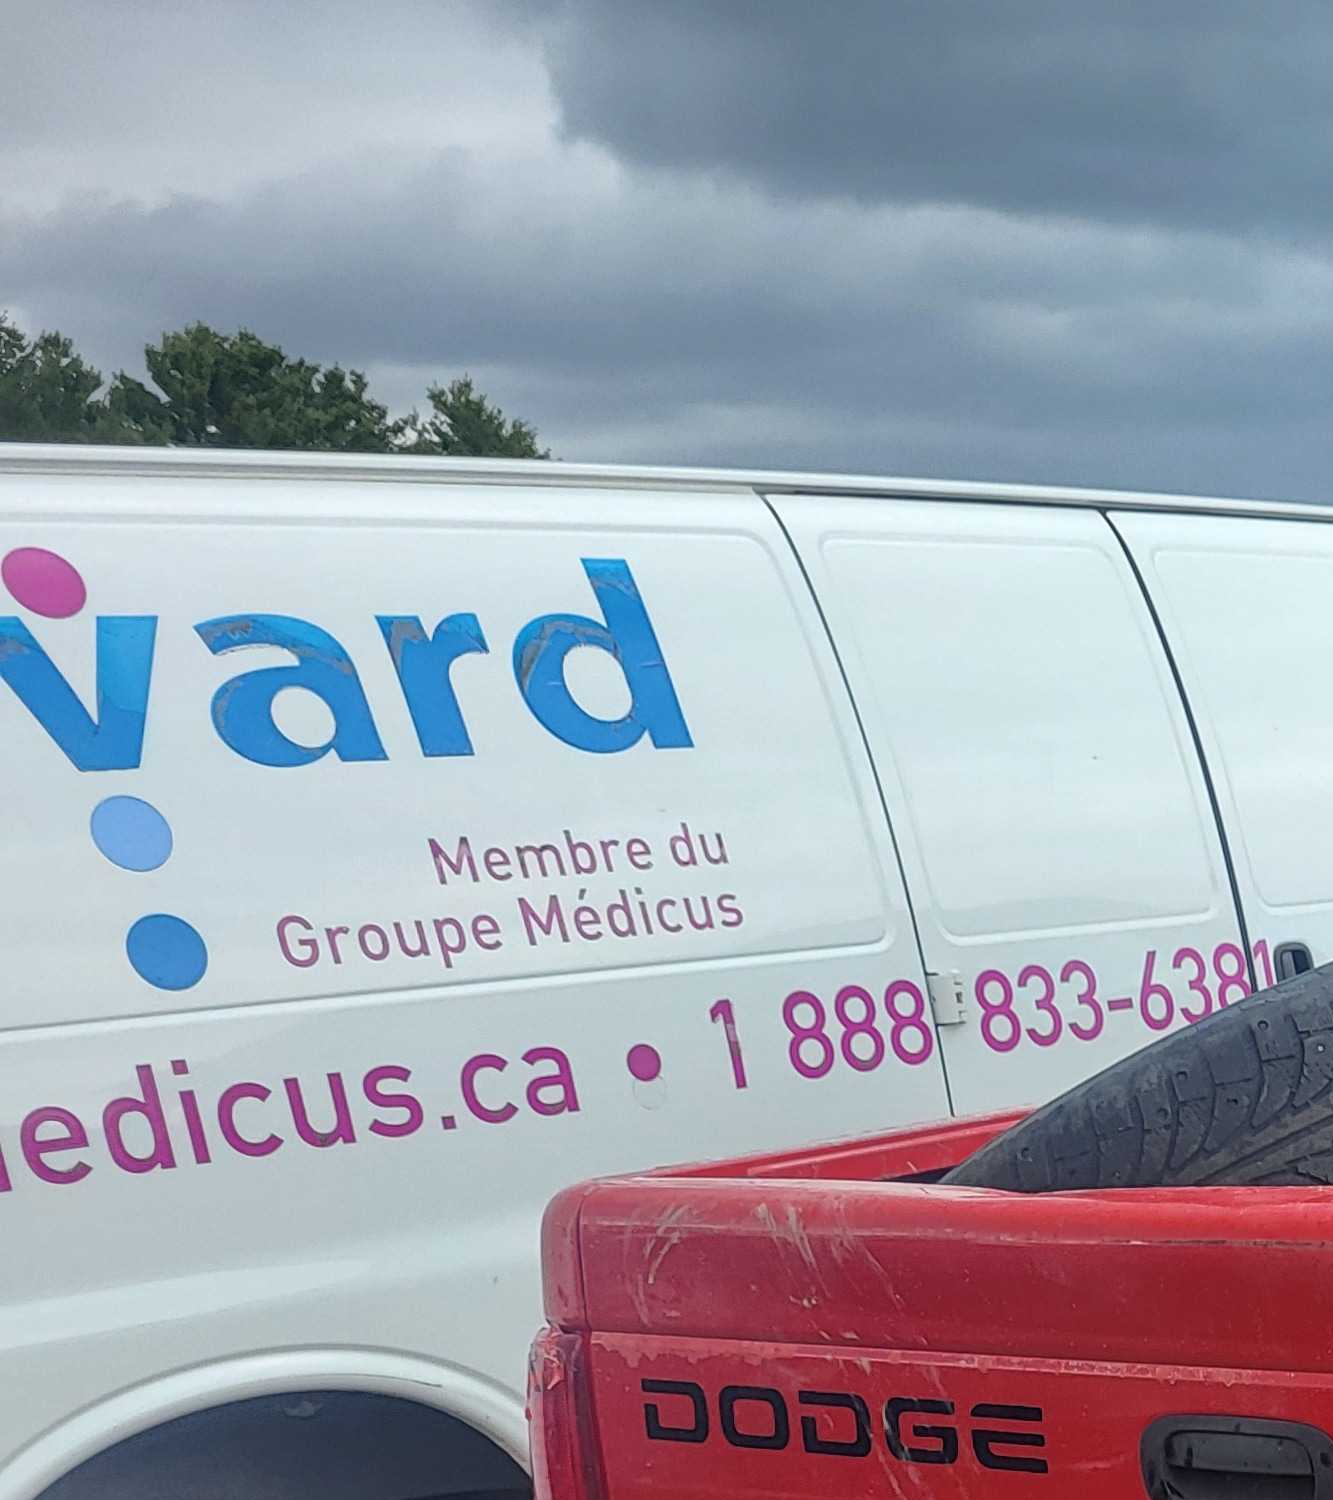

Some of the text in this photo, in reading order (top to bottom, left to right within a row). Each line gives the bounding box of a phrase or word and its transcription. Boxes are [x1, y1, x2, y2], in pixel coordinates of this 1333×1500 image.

[0, 557, 694, 772] vard
[428, 822, 729, 885] Membre du
[276, 888, 744, 968] Groupe Médicus
[709, 999, 748, 1089] 1
[782, 980, 933, 1080] 888
[974, 939, 1275, 1053] 833-6381
[641, 1378, 1048, 1473] DODGE
